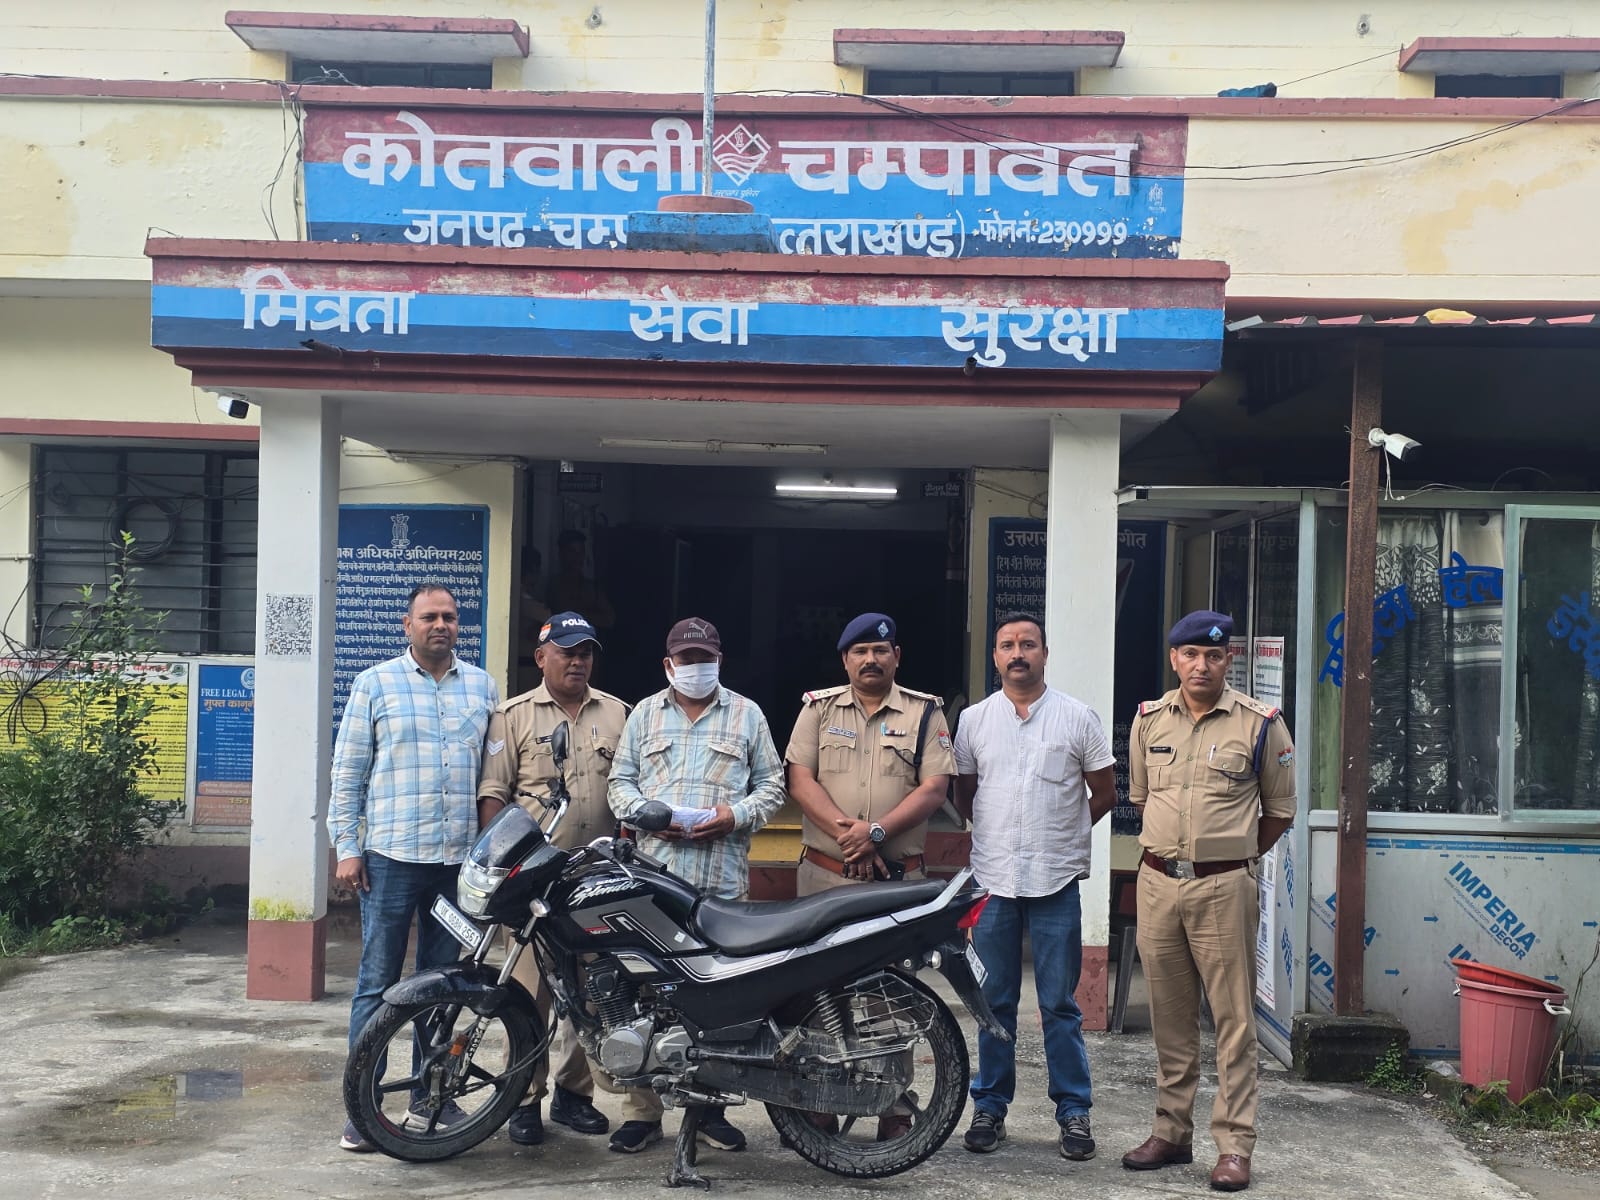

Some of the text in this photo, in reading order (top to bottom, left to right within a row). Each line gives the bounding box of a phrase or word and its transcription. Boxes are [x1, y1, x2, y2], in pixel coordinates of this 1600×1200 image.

[343, 111, 1138, 197] कोतवाली चम्पावत
[240, 267, 1128, 367] मित्रता सेवा सुरक्षा
[356, 543, 403, 561] अधिकार
[201, 688, 220, 697] FREE
[222, 689, 247, 698] LEGAL
[1448, 860, 1536, 952] IMPERIA
[461, 925, 479, 945] 2561
[1489, 923, 1527, 960] DECOR
